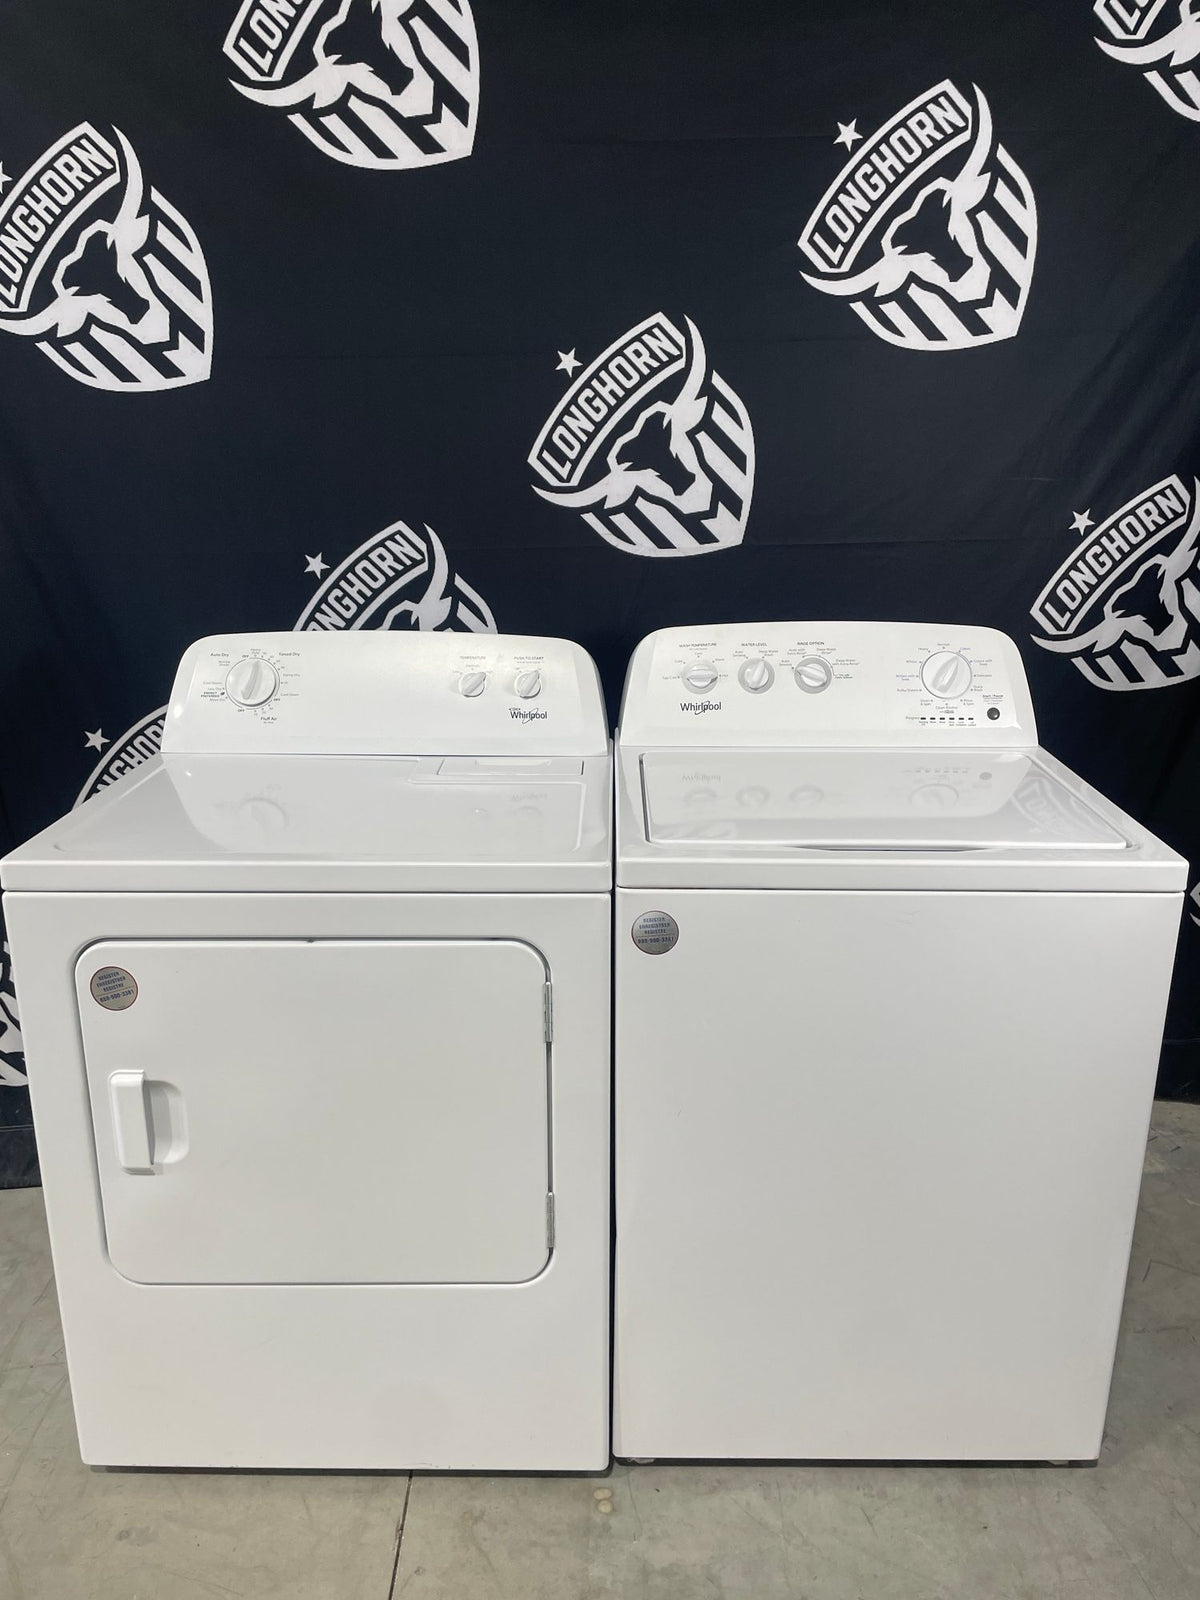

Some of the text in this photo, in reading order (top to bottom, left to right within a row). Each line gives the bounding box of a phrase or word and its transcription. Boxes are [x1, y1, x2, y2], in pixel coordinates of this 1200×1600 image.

[238, 0, 300, 73] LON
[813, 96, 967, 265] LONGHORN
[541, 327, 681, 480] LONGHORN
[306, 534, 423, 631] NGHORN
[1044, 488, 1184, 629] LONGHORN
[510, 710, 548, 722] Whirlpool
[680, 701, 721, 714] Whirlpool
